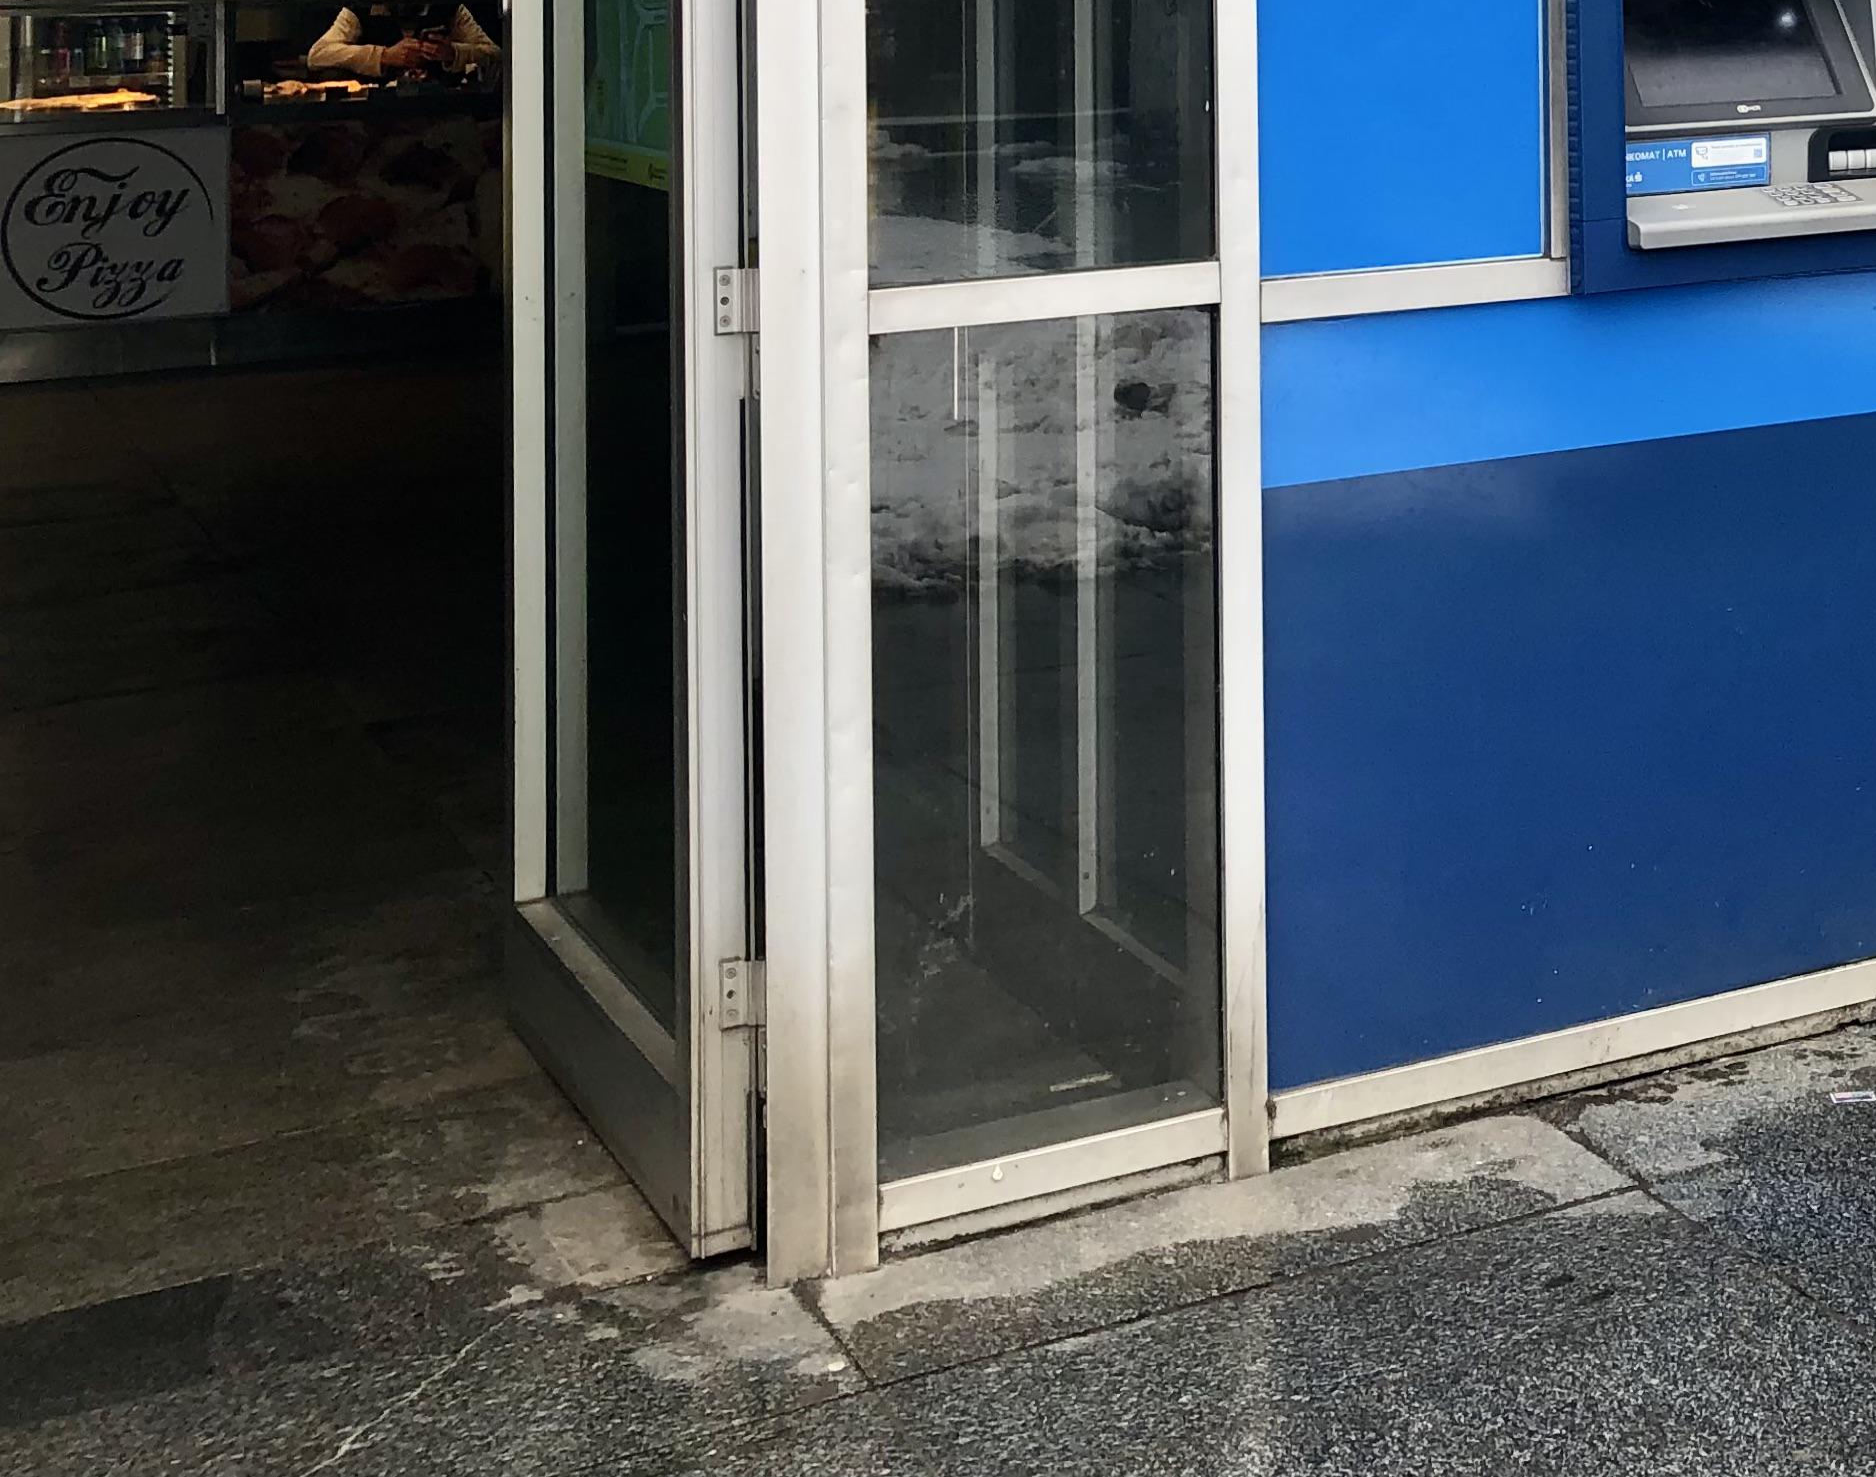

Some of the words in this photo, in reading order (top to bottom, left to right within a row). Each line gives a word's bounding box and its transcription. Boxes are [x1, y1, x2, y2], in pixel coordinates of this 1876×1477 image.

[1667, 149, 1687, 159] ATM
[24, 166, 190, 239] Enjoy
[36, 242, 185, 309] Pizza
